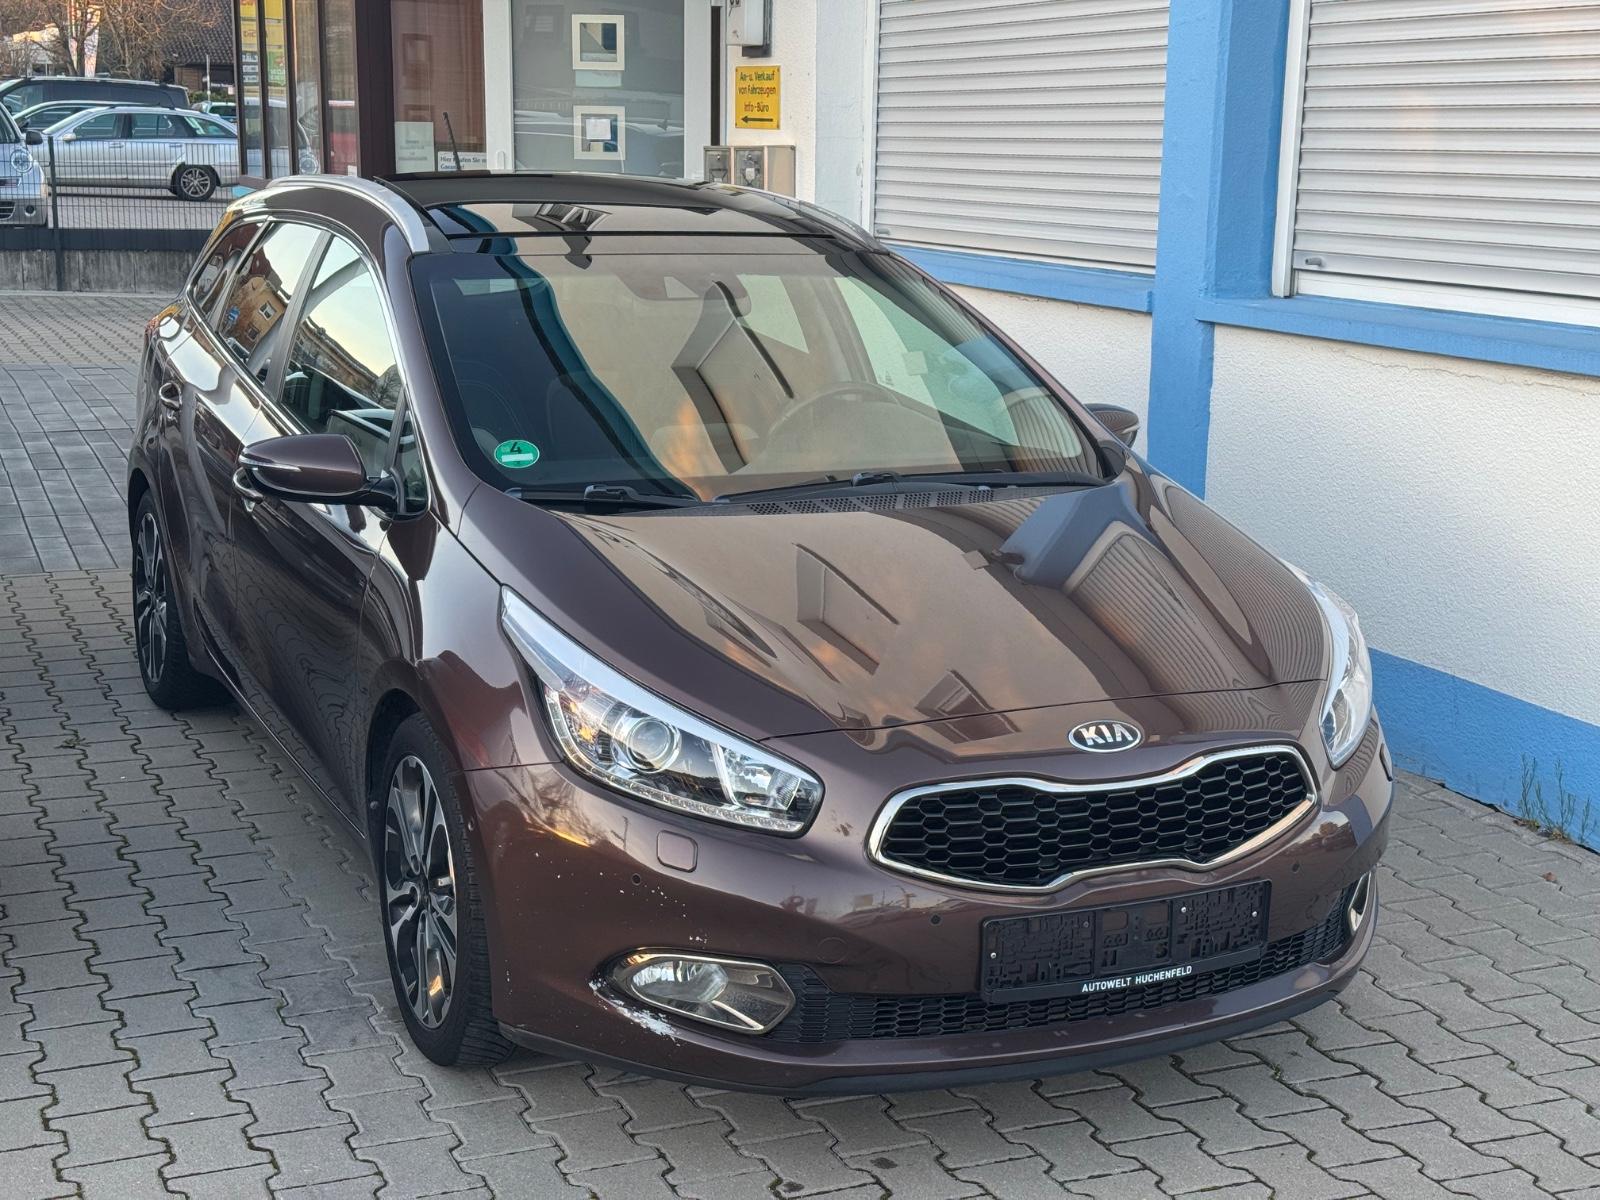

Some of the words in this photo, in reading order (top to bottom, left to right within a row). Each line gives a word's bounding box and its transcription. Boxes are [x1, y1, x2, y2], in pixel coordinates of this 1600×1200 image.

[754, 70, 775, 81] Verkauf
[747, 84, 776, 98] Fahrzeugen
[510, 441, 522, 454] 4
[1078, 723, 1134, 746] KIA
[1081, 977, 1132, 992] AUTOWELT
[1135, 965, 1193, 985] HUCHENFELD
